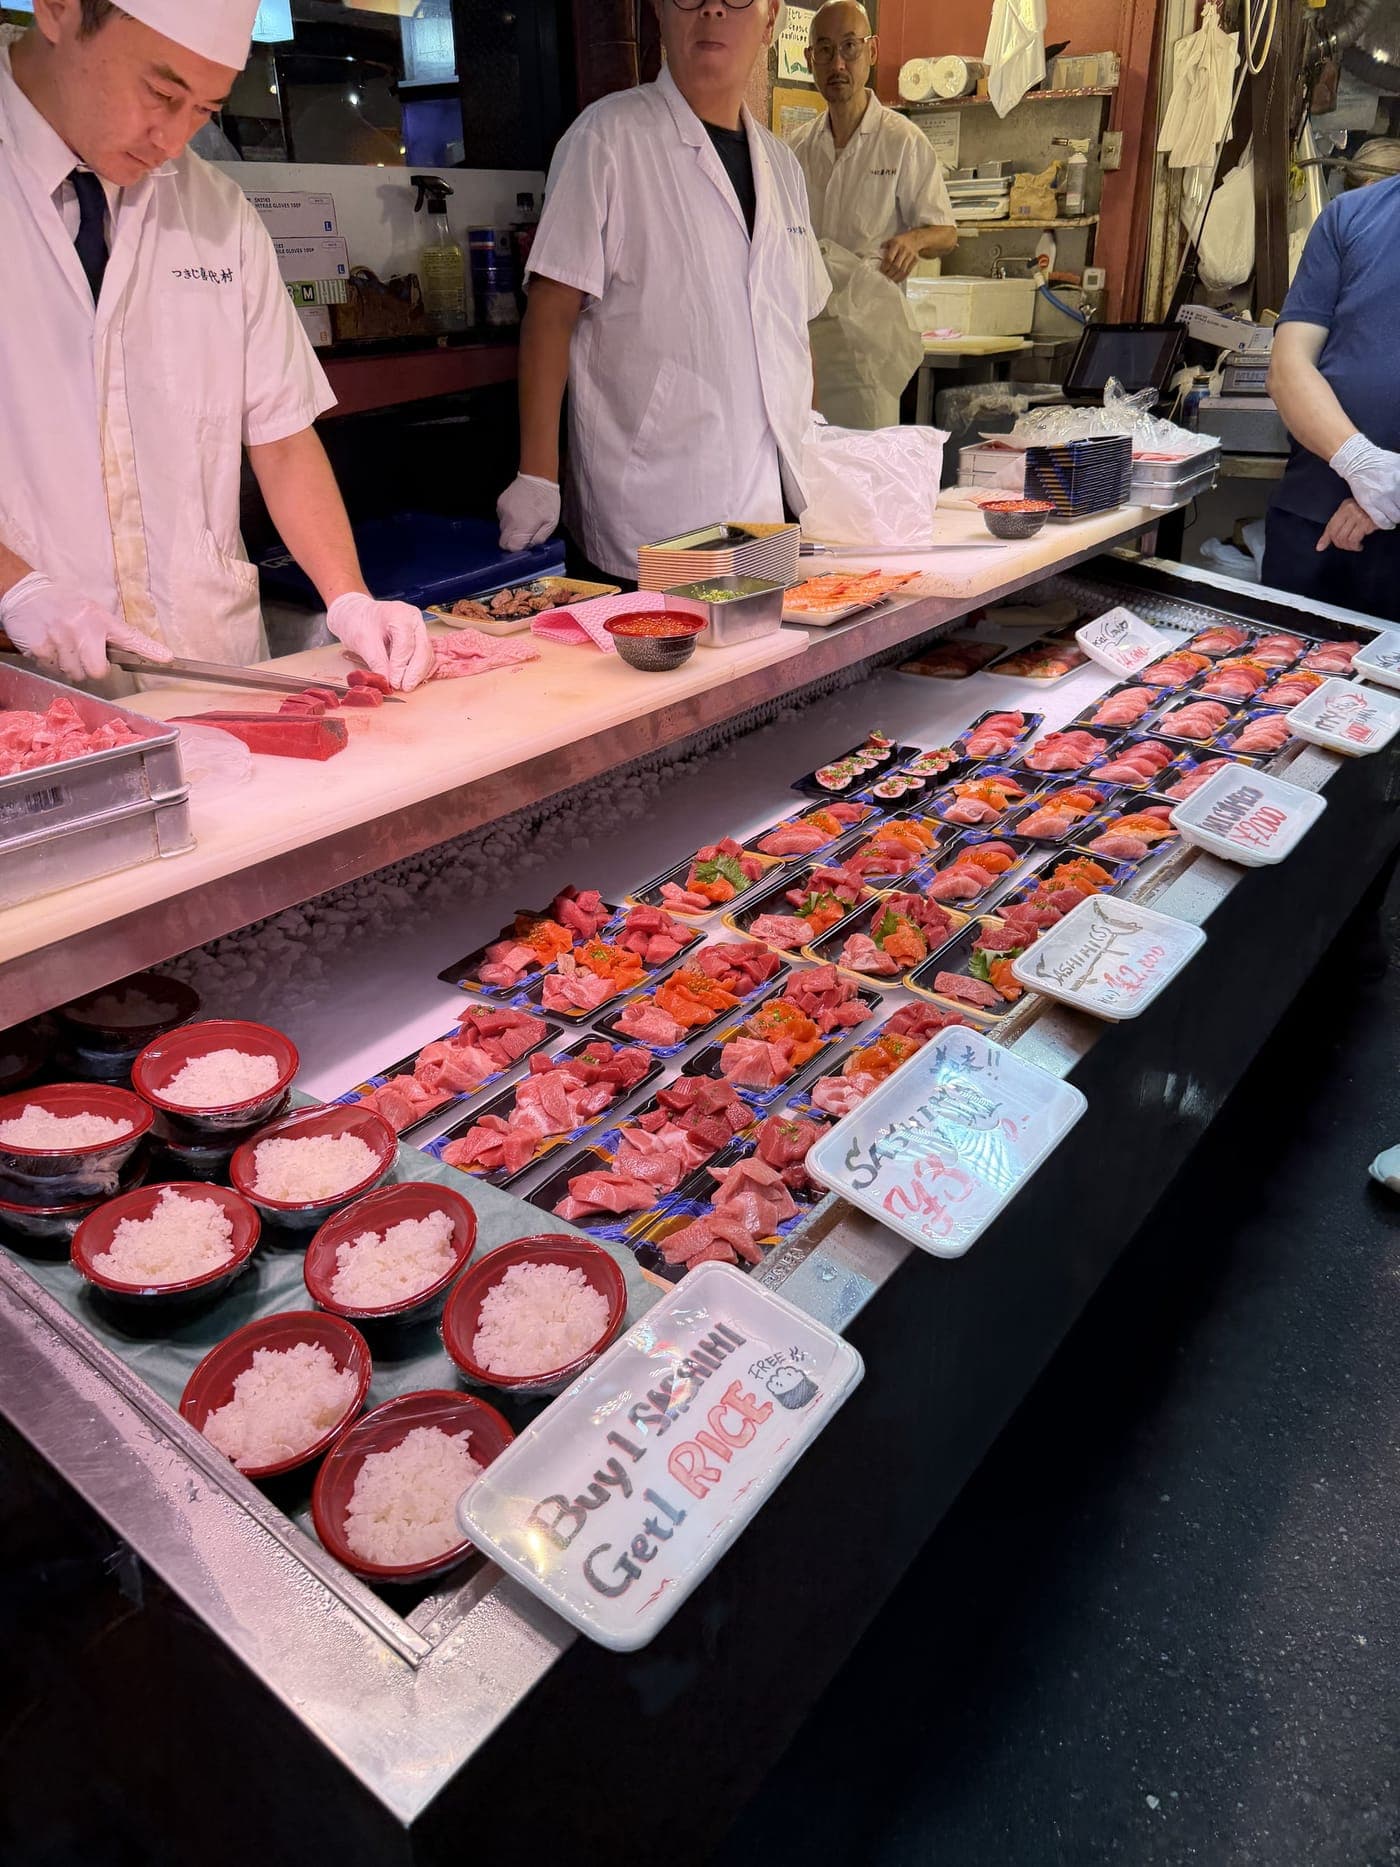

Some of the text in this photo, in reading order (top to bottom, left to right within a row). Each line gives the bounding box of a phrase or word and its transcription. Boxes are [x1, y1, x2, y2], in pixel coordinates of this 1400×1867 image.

[304, 287, 314, 300] M
[747, 1350, 785, 1381] FREE
[667, 1379, 775, 1500] RICE
[528, 1456, 633, 1552] Buy
[606, 1430, 648, 1463] 1
